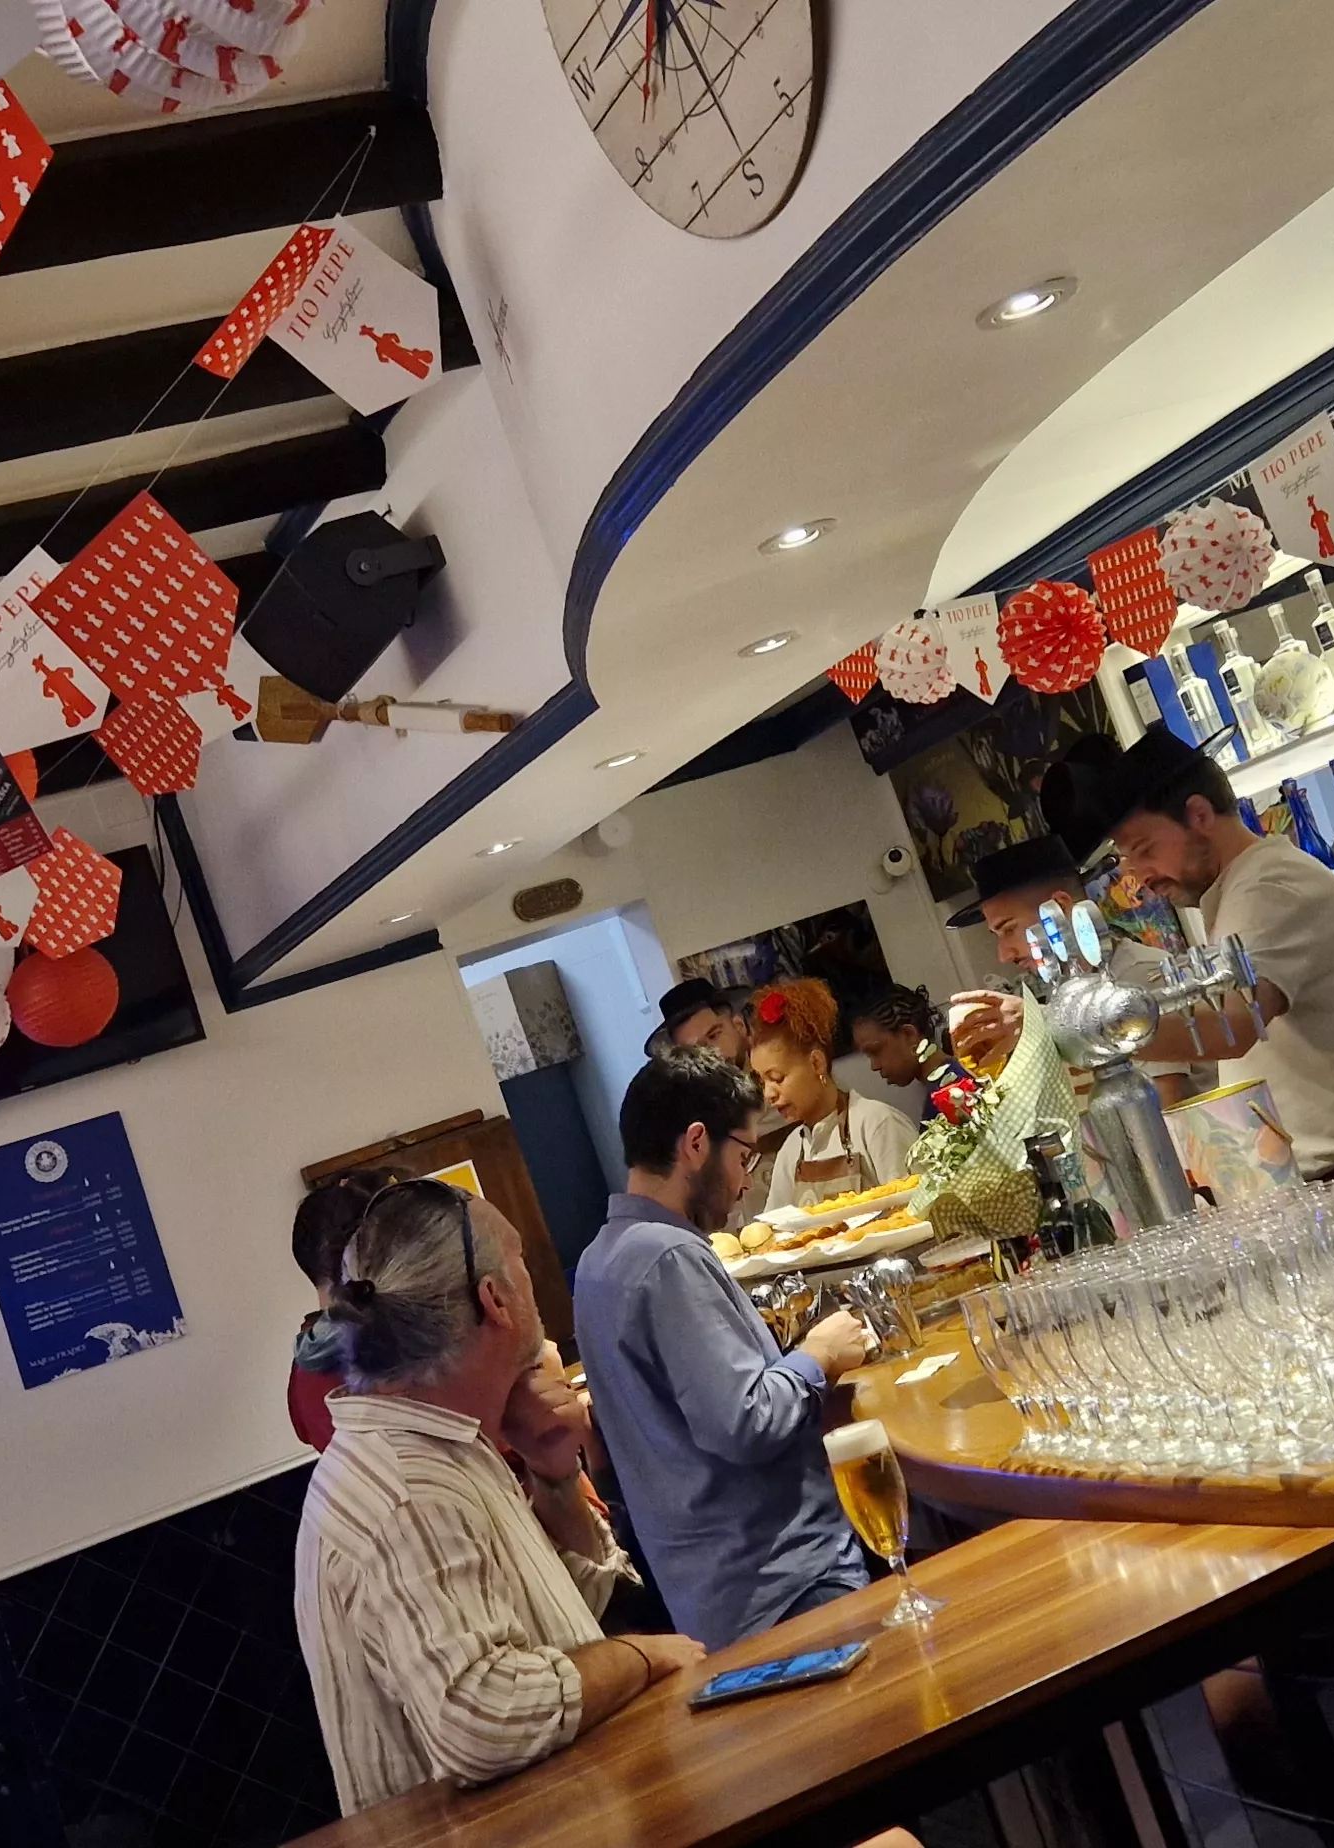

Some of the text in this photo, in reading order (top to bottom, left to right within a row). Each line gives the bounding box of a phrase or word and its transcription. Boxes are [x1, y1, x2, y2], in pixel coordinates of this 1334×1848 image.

[571, 56, 596, 102] W
[773, 76, 795, 118] 5
[635, 146, 653, 182] 8
[742, 158, 765, 200] S
[691, 180, 709, 218] 7
[286, 238, 355, 342] TIO PEPE
[1260, 458, 1286, 484] TIO
[1288, 430, 1327, 466] PEPE
[966, 603, 992, 620] PEPE
